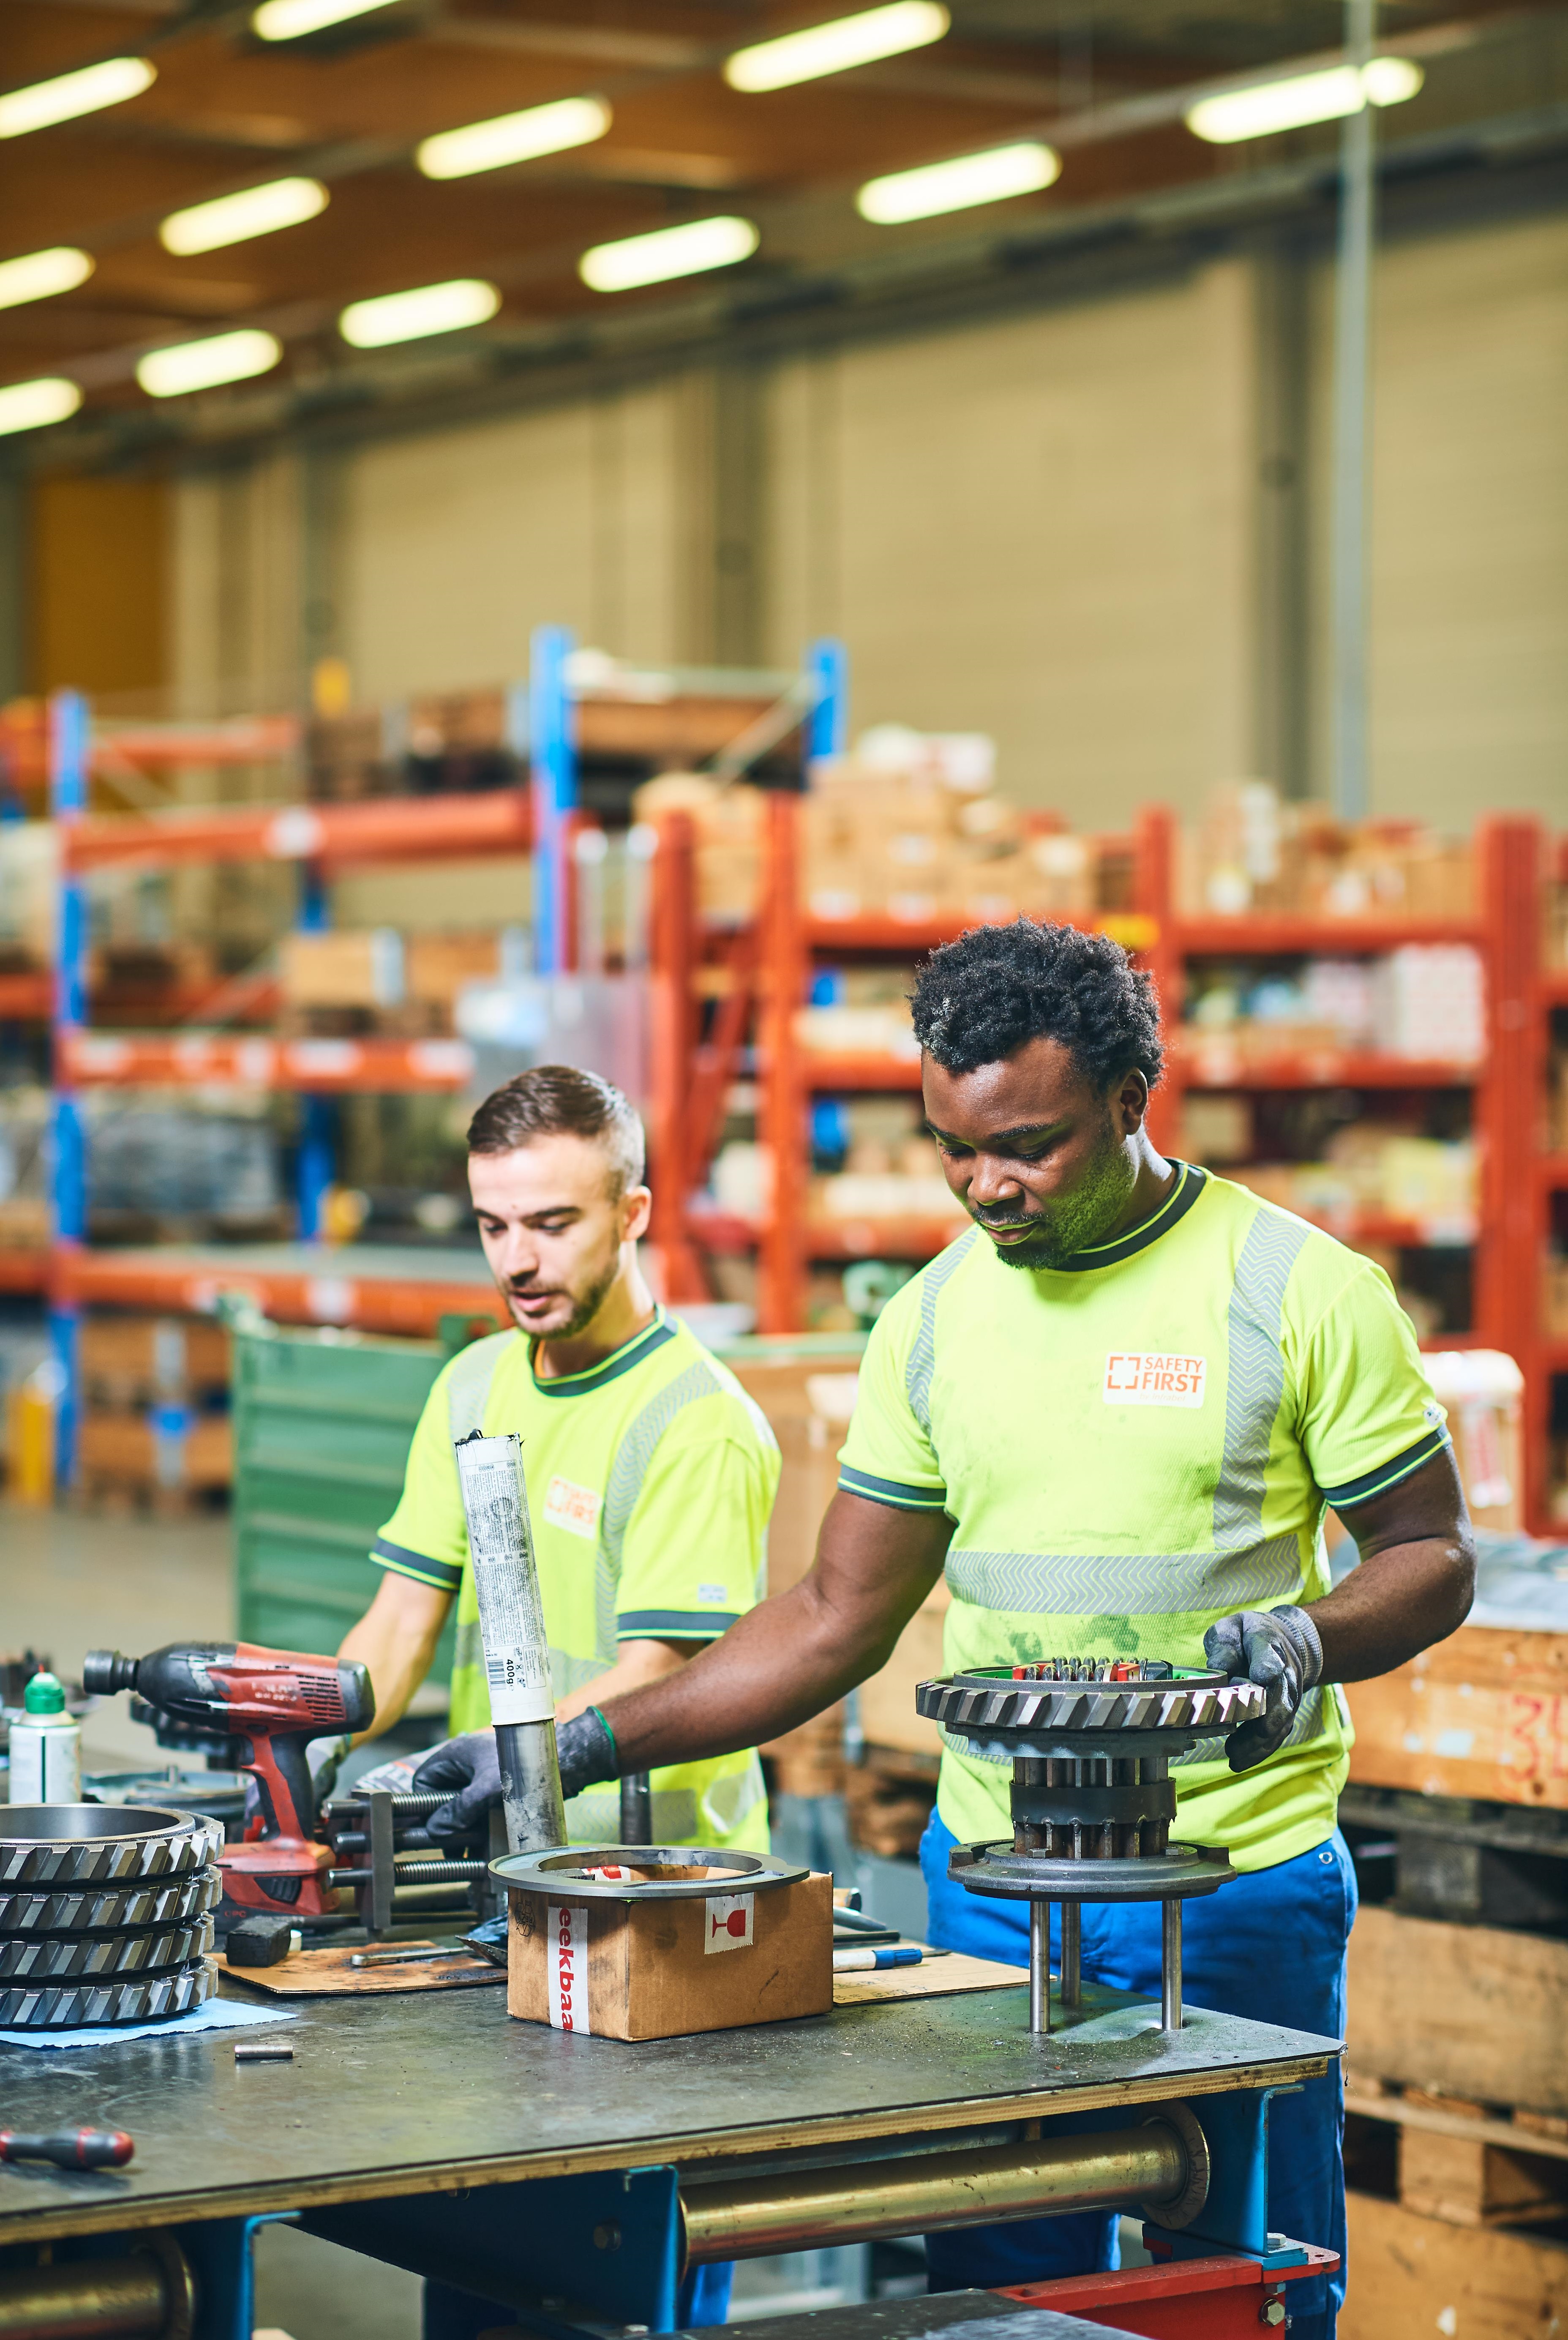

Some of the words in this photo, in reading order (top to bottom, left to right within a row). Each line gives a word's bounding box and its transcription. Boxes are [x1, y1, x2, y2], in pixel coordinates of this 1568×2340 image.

[1144, 1357, 1203, 1373] SAFETY
[1142, 1372, 1202, 1393] FIRST
[506, 1659, 515, 1684] 400g
[559, 1908, 573, 2030] eekbaa
